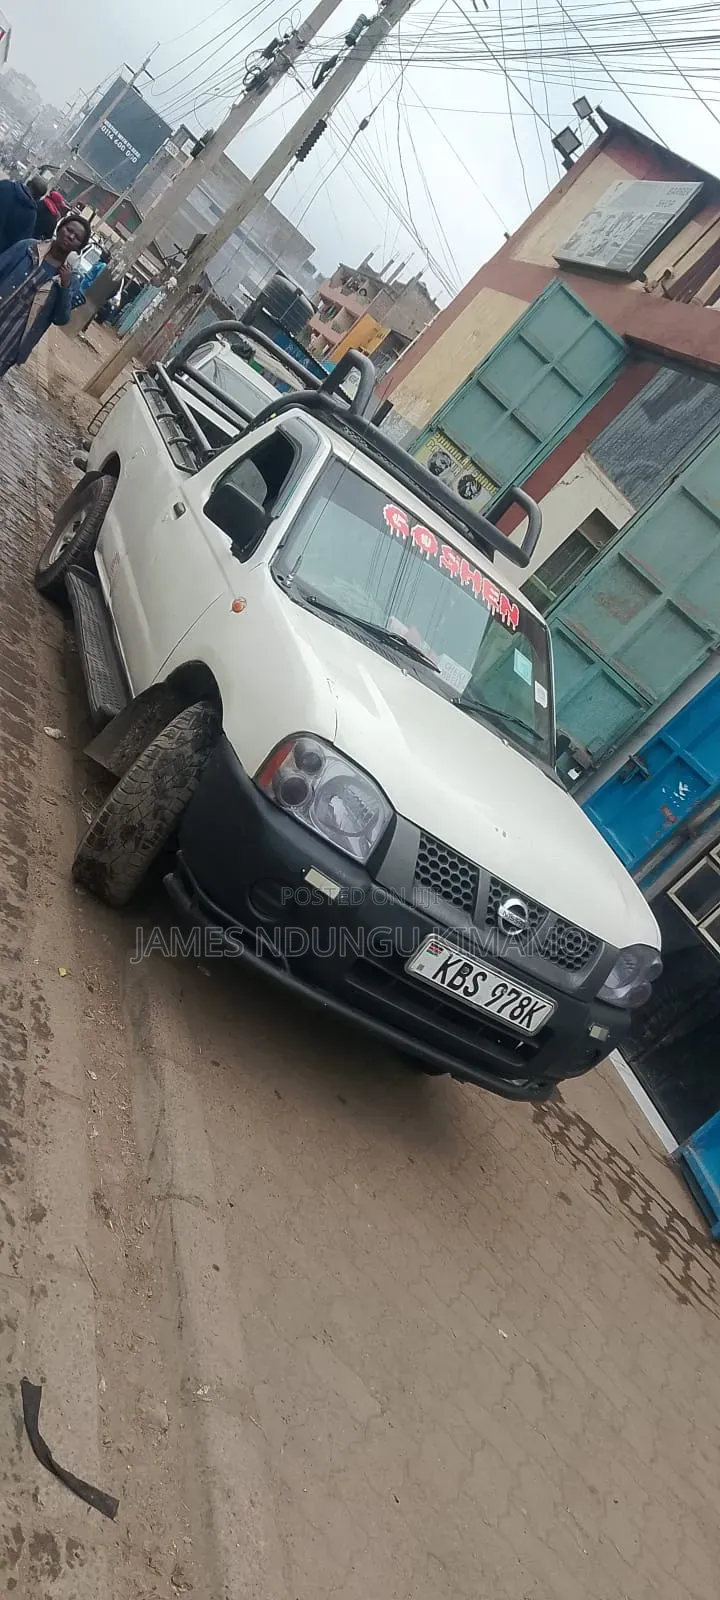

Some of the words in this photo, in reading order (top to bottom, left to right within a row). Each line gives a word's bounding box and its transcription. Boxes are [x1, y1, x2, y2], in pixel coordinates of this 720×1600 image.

[101, 125, 114, 140] 0114
[114, 139, 126, 151] 600
[125, 150, 137, 163] 000
[383, 504, 519, 631] GOSHEN
[432, 952, 488, 998] KBS
[484, 982, 547, 1029] 978K
